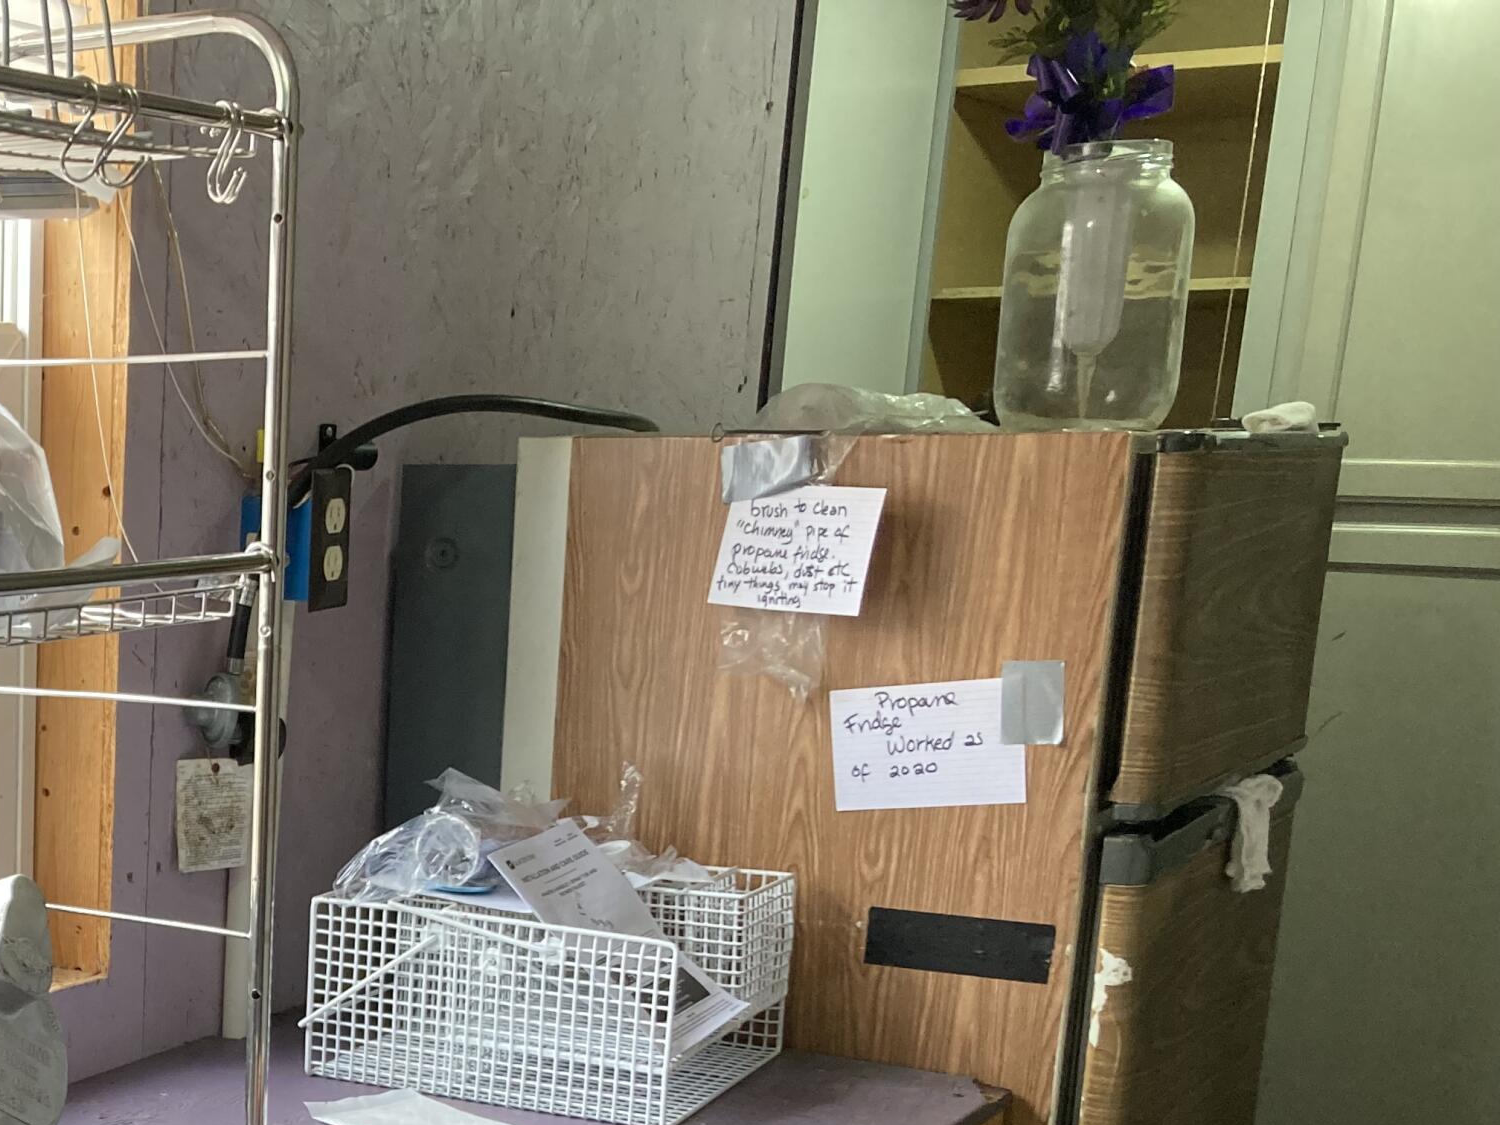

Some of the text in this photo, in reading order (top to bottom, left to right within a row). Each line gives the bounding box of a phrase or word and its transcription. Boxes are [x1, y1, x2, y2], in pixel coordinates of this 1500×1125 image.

[751, 499, 788, 517] brush
[794, 502, 807, 513] to
[834, 525, 850, 543] of
[732, 543, 787, 560] propane
[717, 576, 741, 593] tiny
[788, 581, 810, 596] may
[813, 579, 836, 597] stop
[843, 577, 857, 593] it
[874, 691, 959, 716] Propane
[963, 732, 983, 747] as
[851, 762, 938, 783] of 2020
